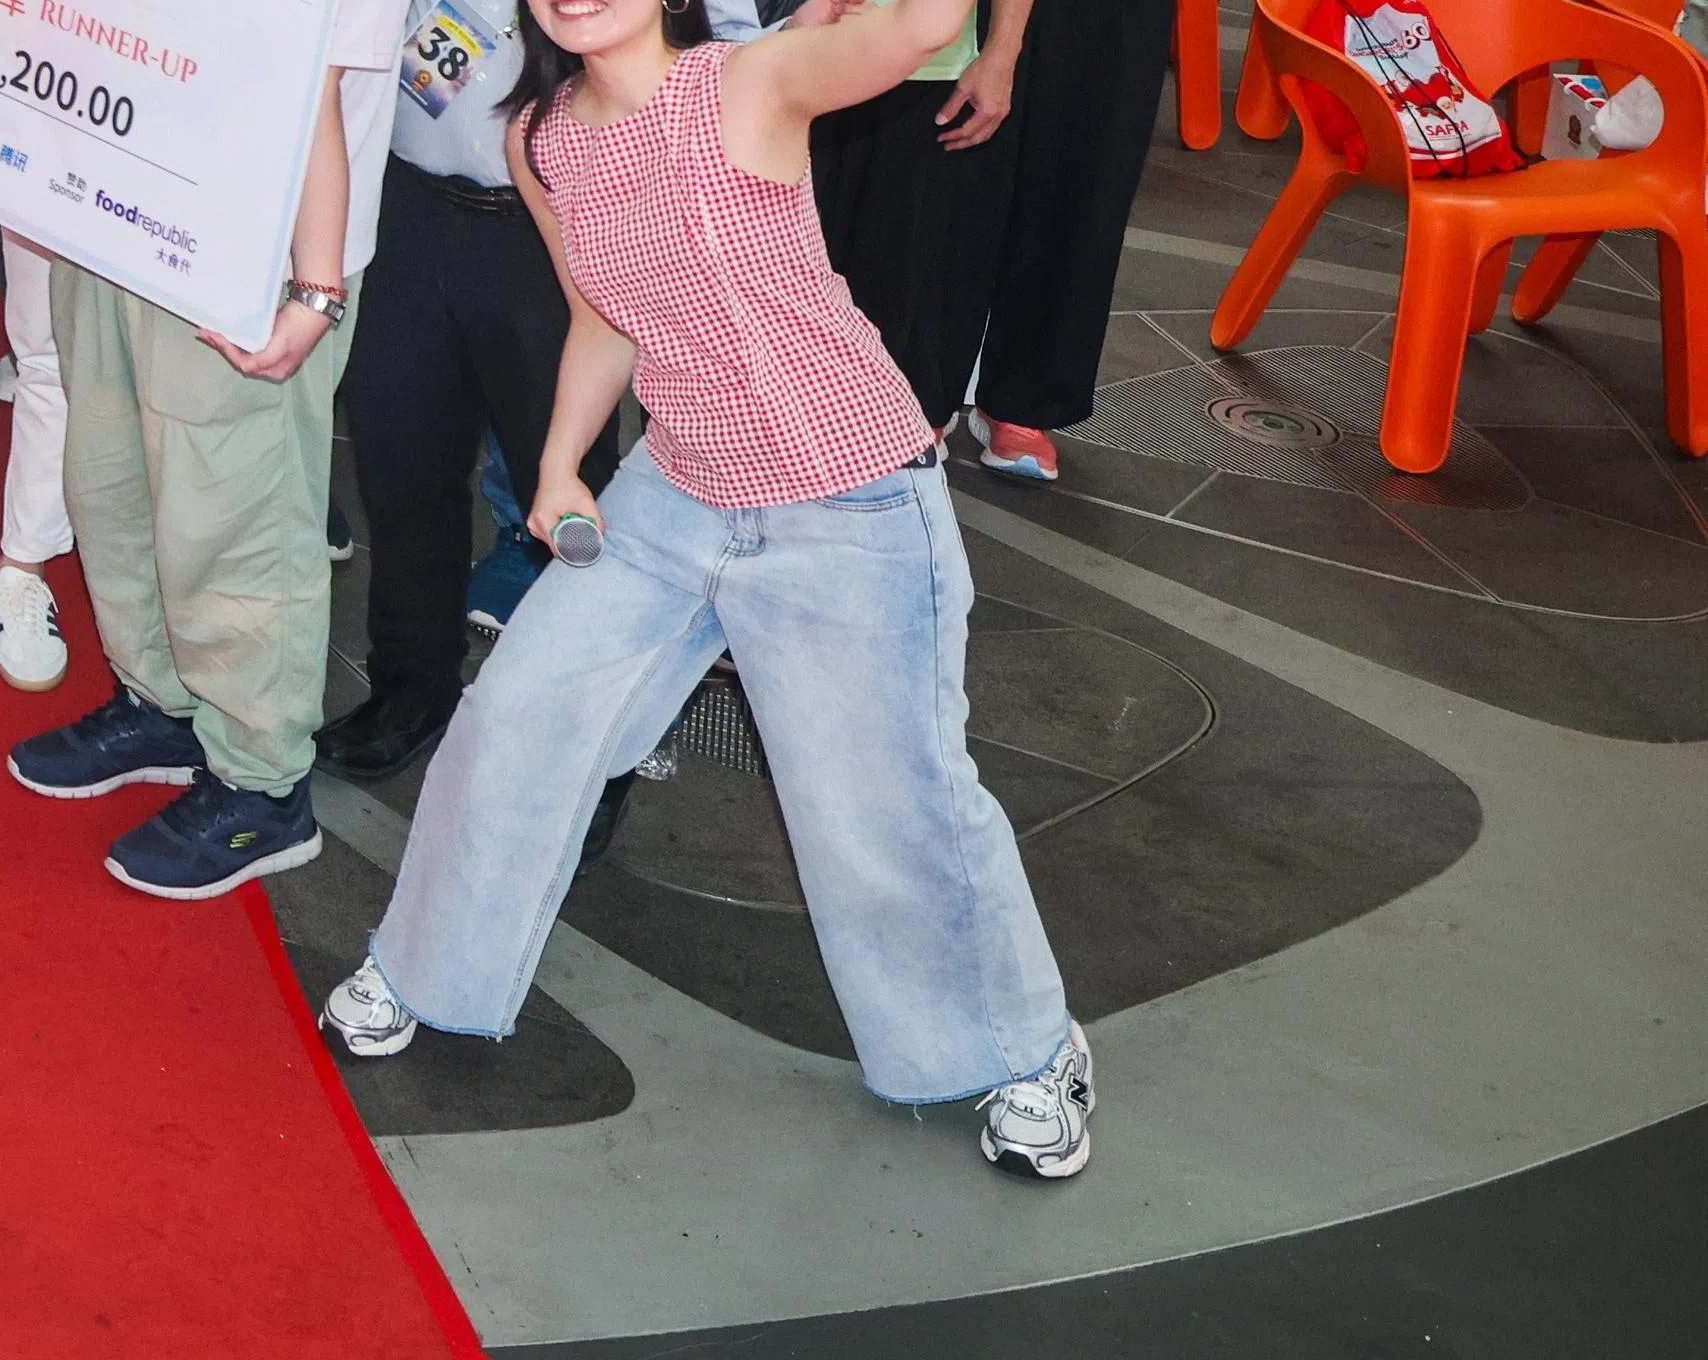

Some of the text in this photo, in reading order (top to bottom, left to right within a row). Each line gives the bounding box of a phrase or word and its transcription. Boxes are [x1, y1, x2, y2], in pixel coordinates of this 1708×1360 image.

[1401, 22, 1432, 50] 60
[418, 26, 469, 81] 38
[49, 178, 84, 204] Sponsor
[95, 189, 198, 254] foodrepublic
[154, 247, 192, 276] 大食代
[1067, 1073, 1089, 1112] N
